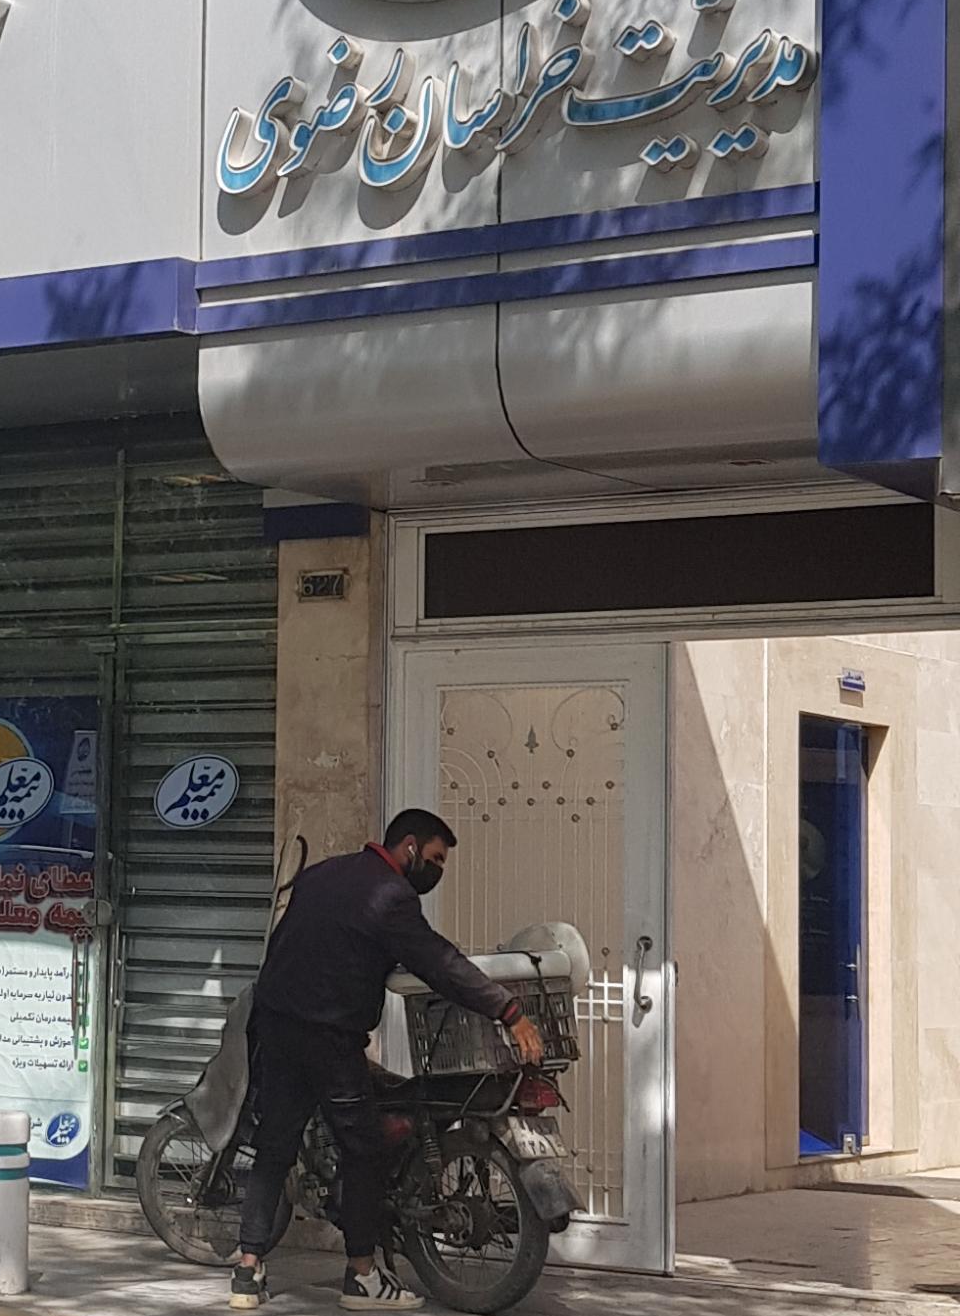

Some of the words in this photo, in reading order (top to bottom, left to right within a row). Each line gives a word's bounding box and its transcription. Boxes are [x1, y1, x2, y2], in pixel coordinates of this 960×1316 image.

[215, 35, 409, 195] رضوی
[181, 783, 224, 821] بیمه
[28, 864, 94, 900] عطای
[33, 966, 53, 981] پایدار
[53, 966, 72, 980] رآمد
[9, 1012, 35, 1024] تکمیلی
[35, 1012, 56, 1024] درمان
[11, 1034, 43, 1048] پشتیبانی
[12, 1057, 26, 1069] ویژه
[27, 1058, 58, 1071] تسهیلات
